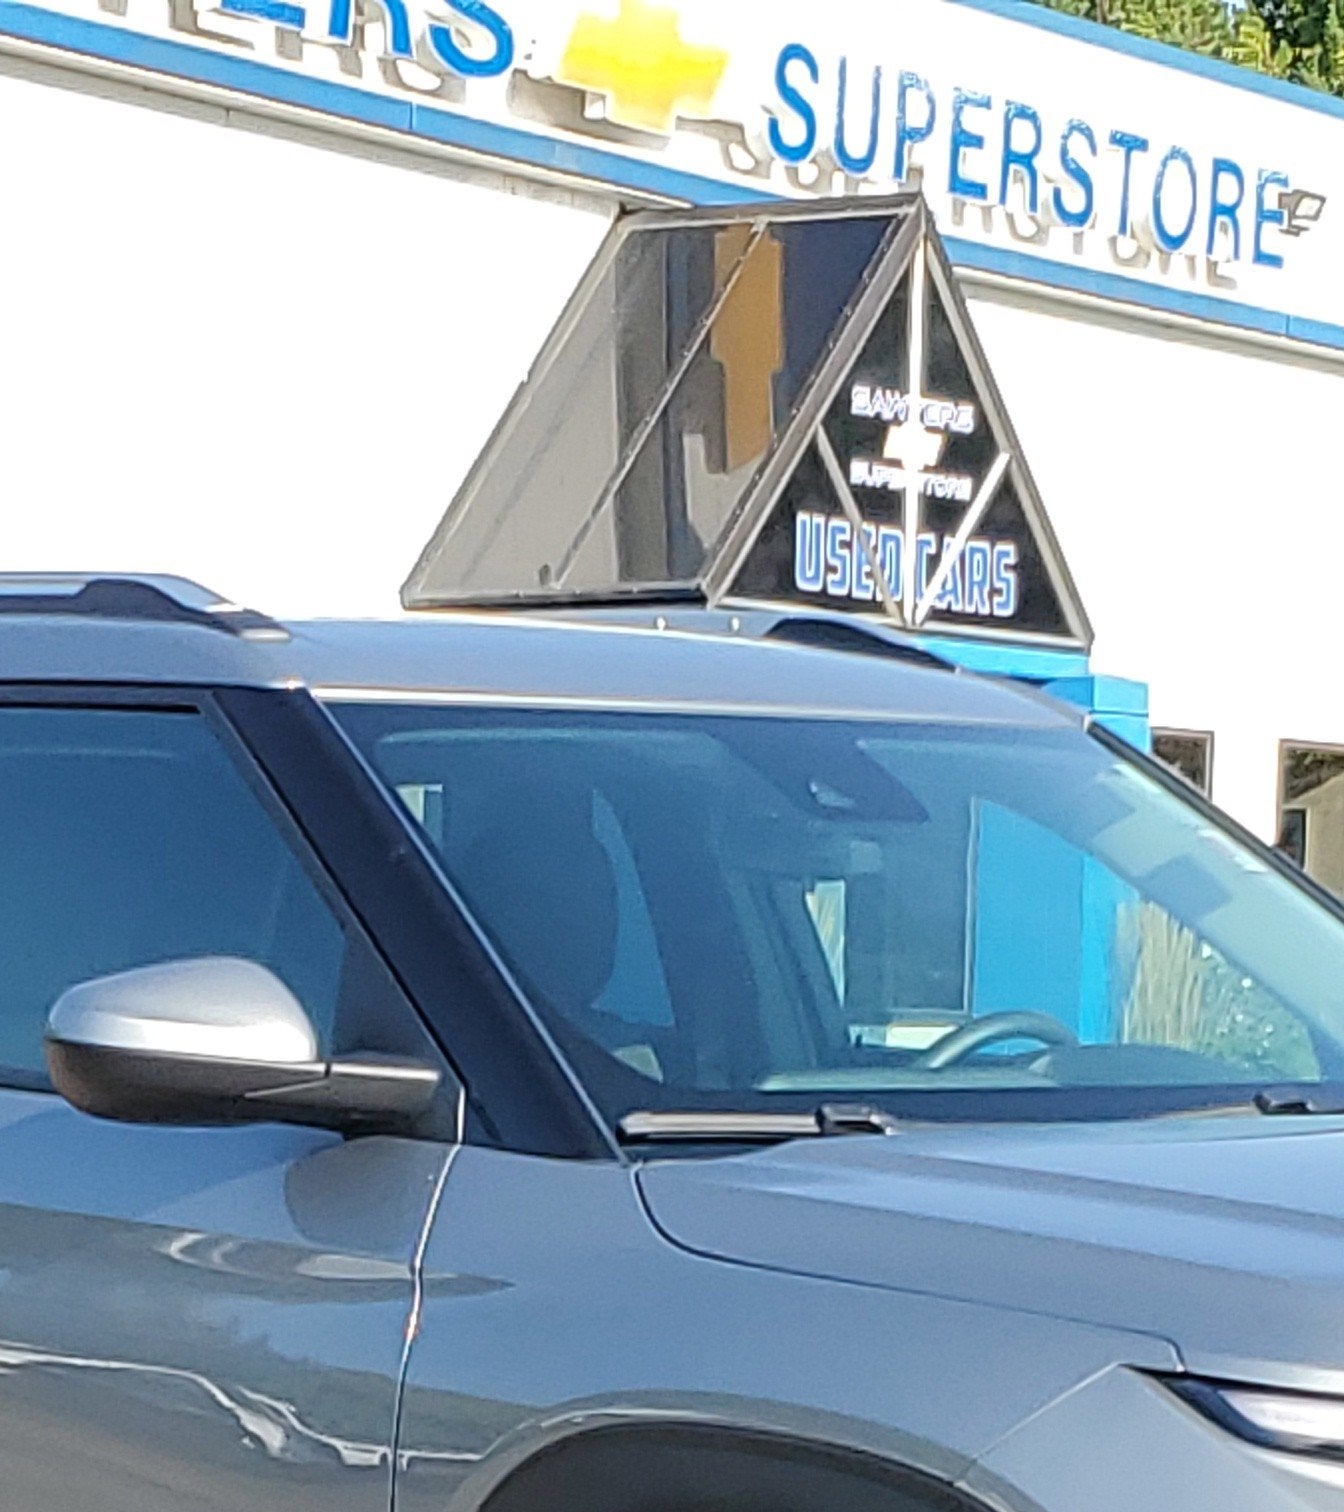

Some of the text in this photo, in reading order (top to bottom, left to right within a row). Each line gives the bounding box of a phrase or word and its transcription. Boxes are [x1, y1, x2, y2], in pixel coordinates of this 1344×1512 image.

[767, 43, 1291, 268] SUPERSTORE
[851, 385, 975, 434] SAWERS
[794, 510, 1019, 618] USED CARS
